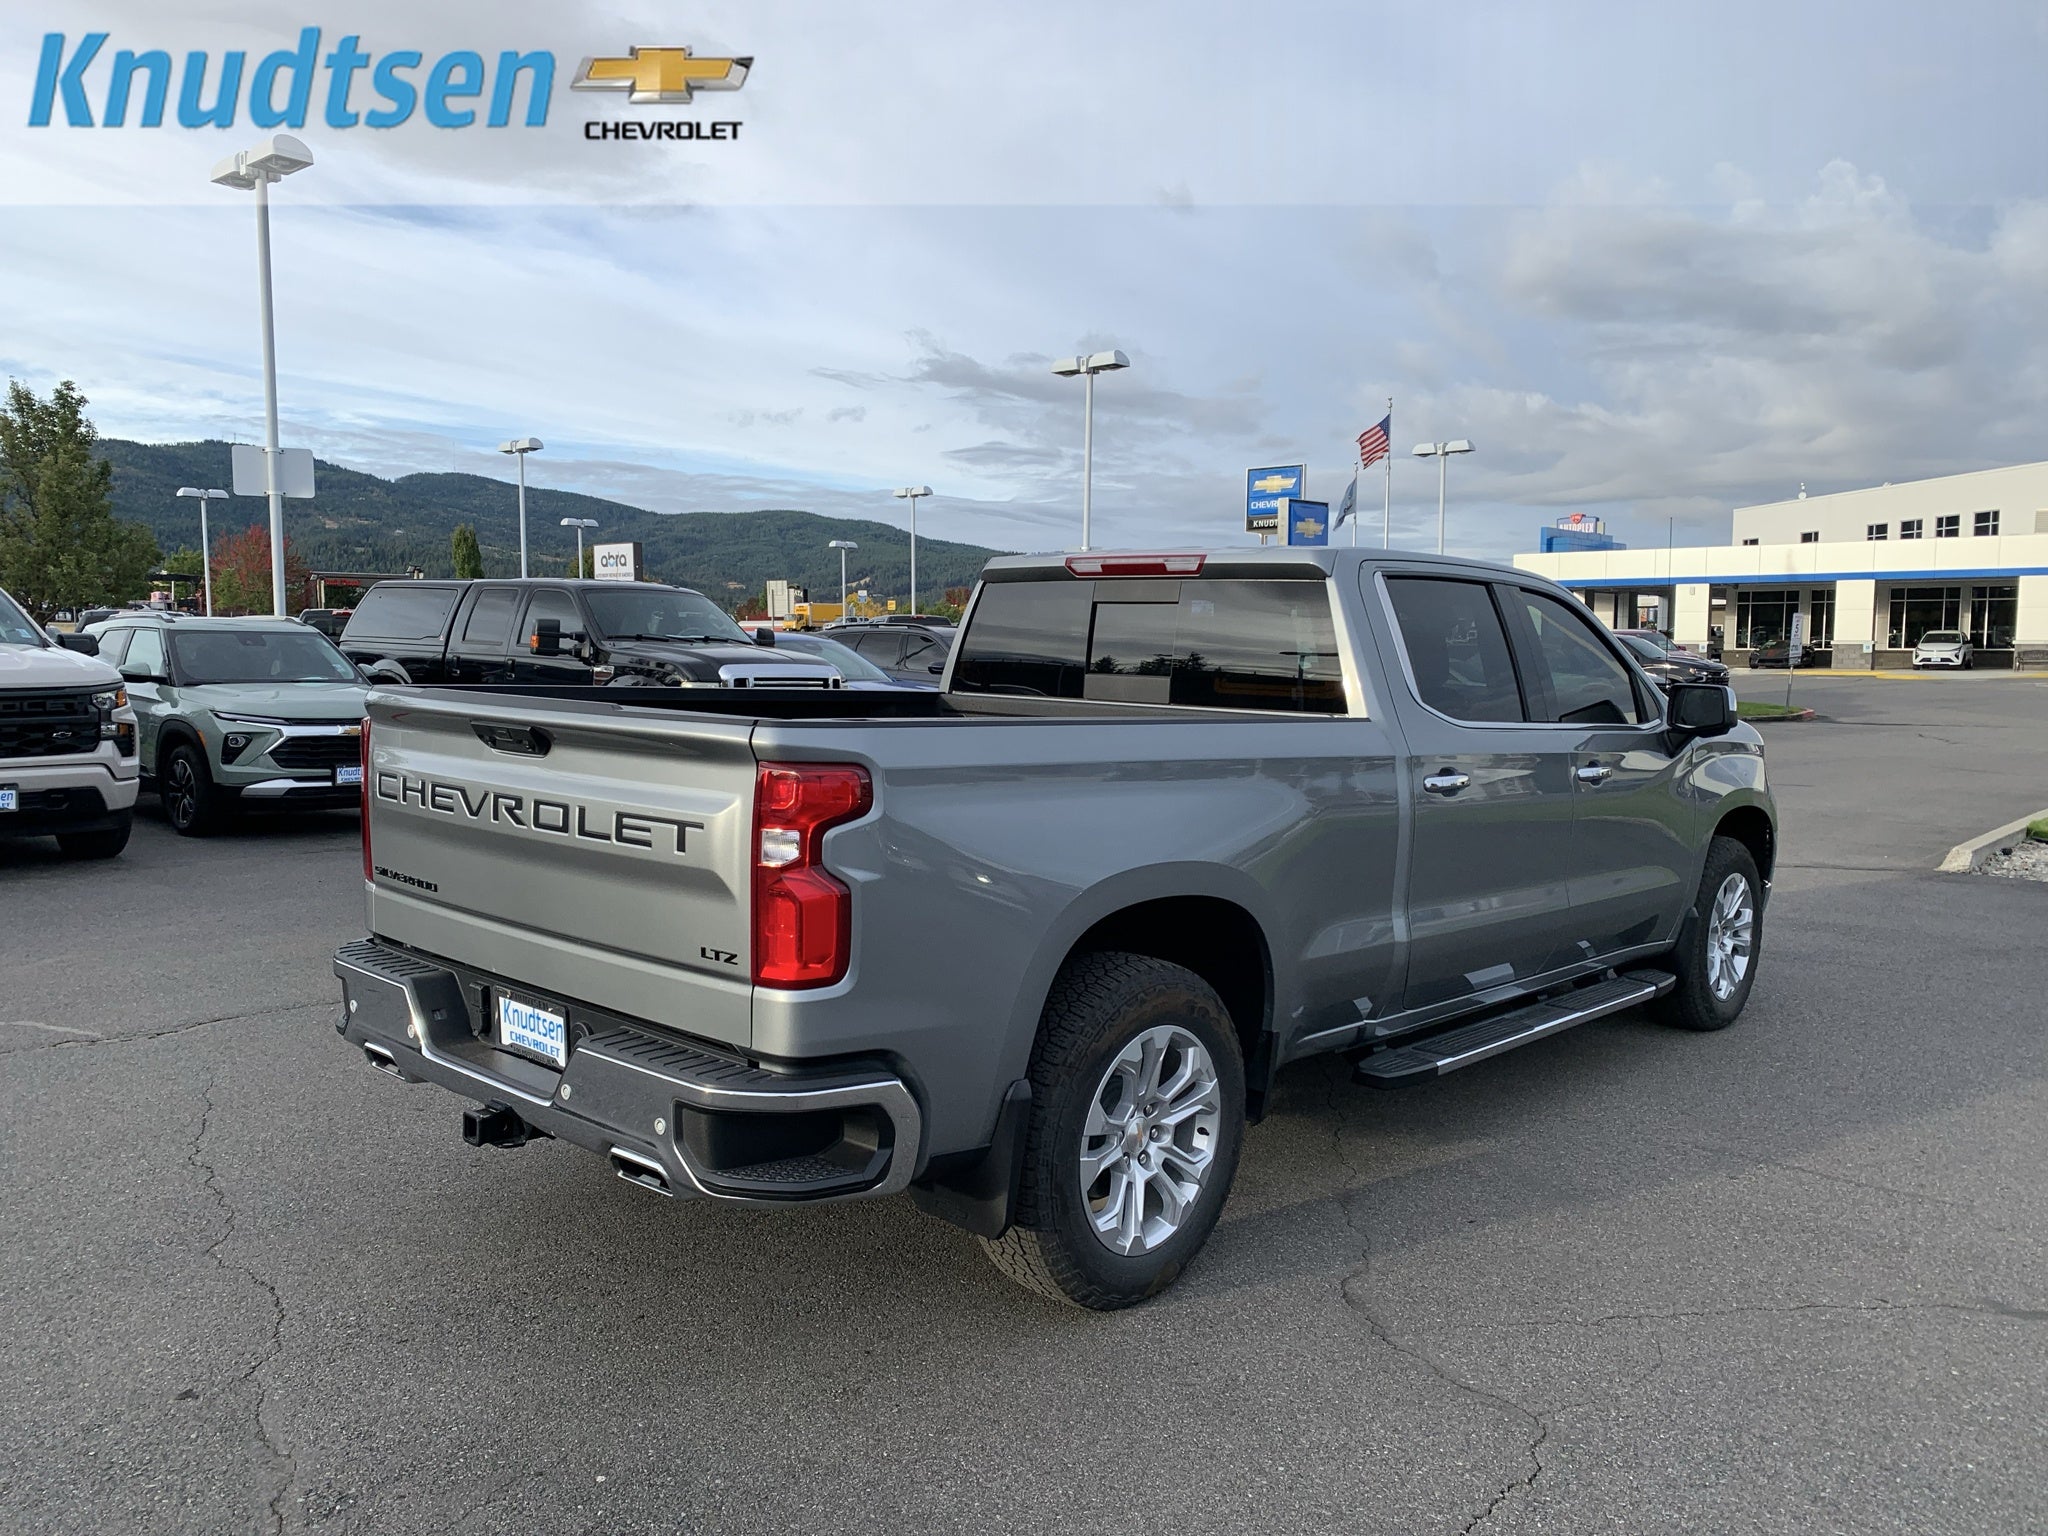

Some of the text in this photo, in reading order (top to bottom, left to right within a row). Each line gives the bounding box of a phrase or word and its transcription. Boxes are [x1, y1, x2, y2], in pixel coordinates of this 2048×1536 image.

[1251, 500, 1278, 509] CHEVR
[1253, 519, 1278, 528] KNUDT
[338, 768, 360, 776] Knudt
[376, 770, 705, 854] CHEVROLET
[375, 865, 438, 893] SILVERADO
[700, 946, 738, 966] LTZ
[504, 999, 563, 1043] Knudtsen
[510, 1030, 560, 1058] CHEVROLET
